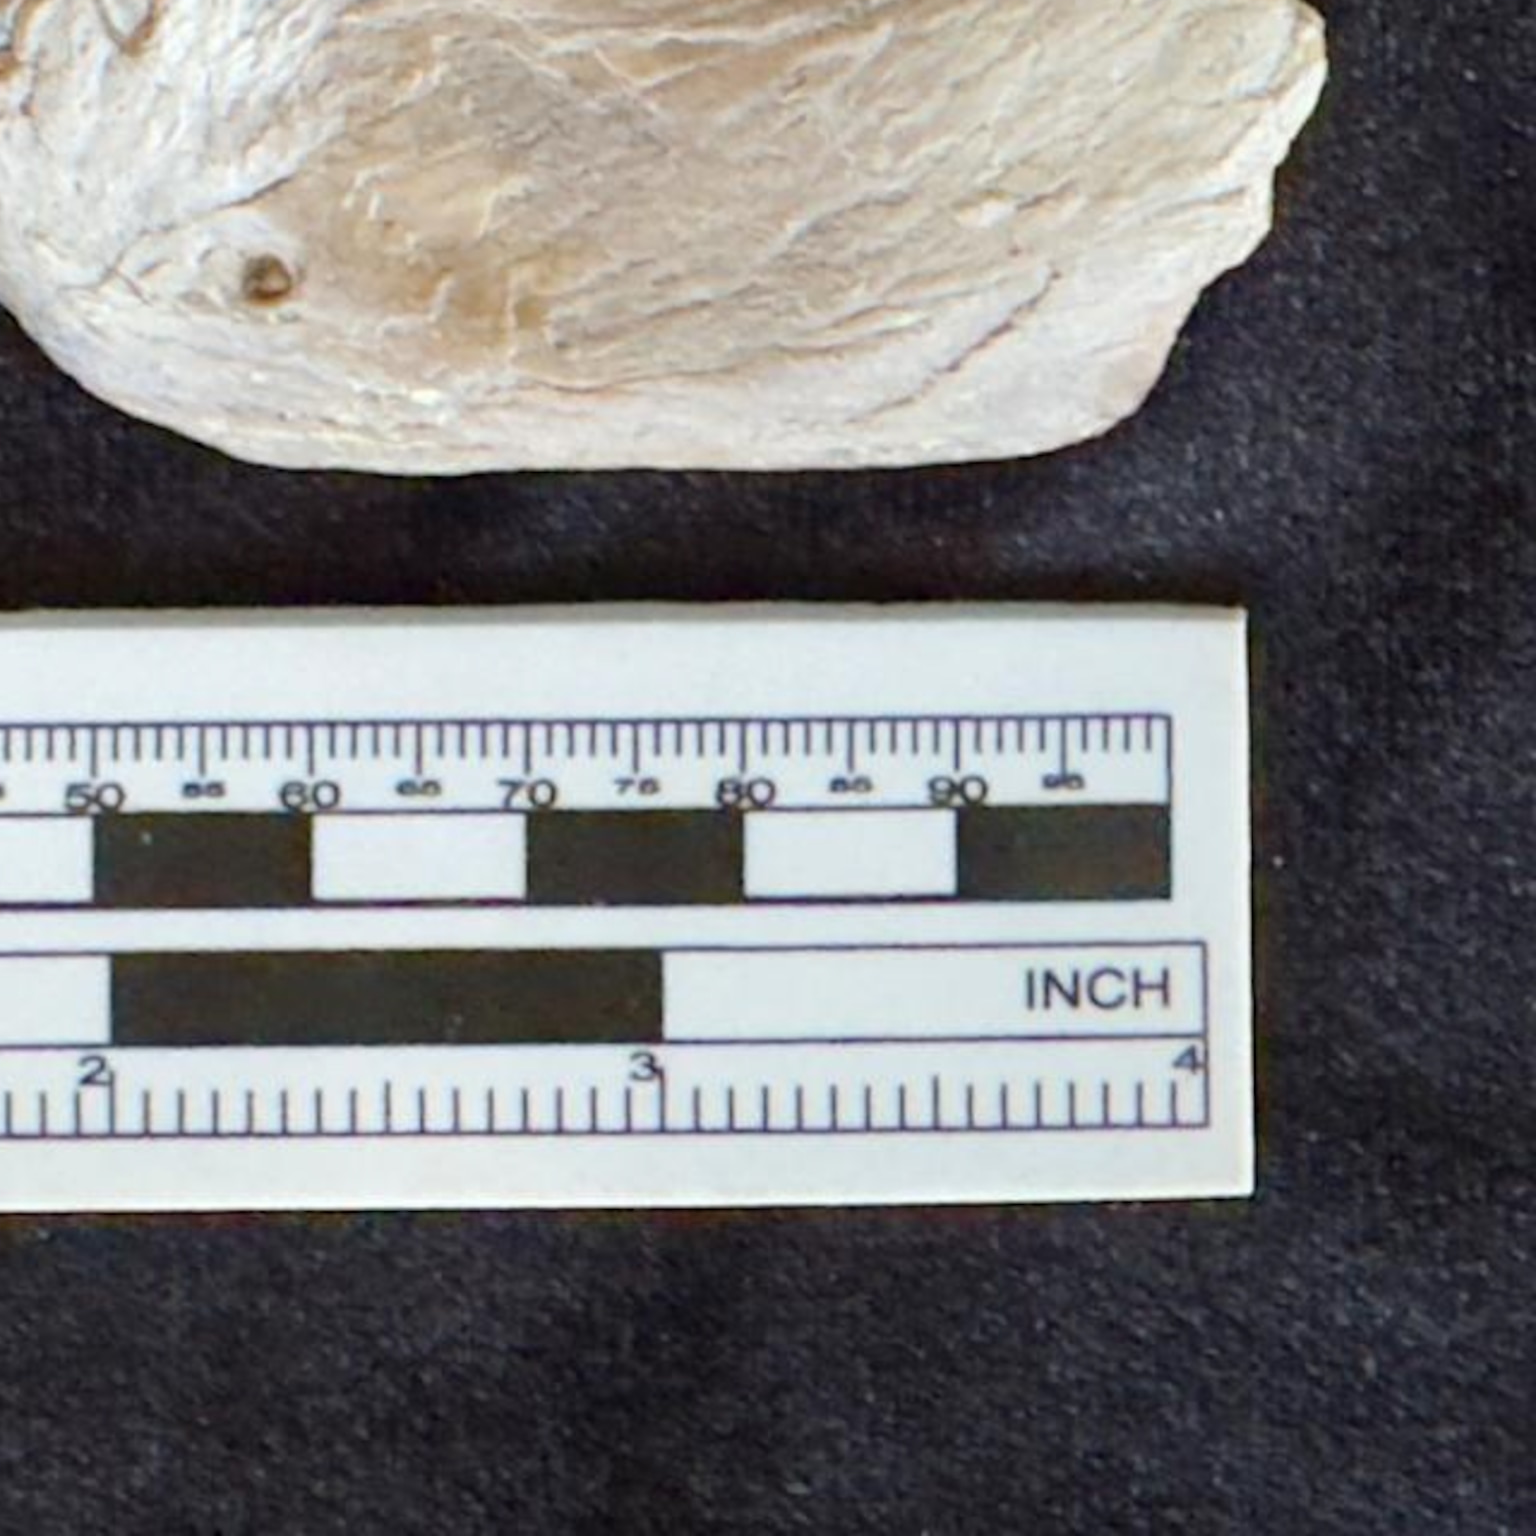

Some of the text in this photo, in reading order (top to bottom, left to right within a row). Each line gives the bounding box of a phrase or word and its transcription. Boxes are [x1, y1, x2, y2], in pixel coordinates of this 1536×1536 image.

[64, 783, 126, 814] 50
[279, 780, 341, 811] 60
[496, 779, 557, 810] 70
[716, 777, 775, 807] 80
[928, 776, 987, 805] 90
[1026, 967, 1170, 1010] INCH
[78, 1055, 110, 1085] 2
[630, 1052, 658, 1082] 3
[1172, 1044, 1203, 1073] 4
